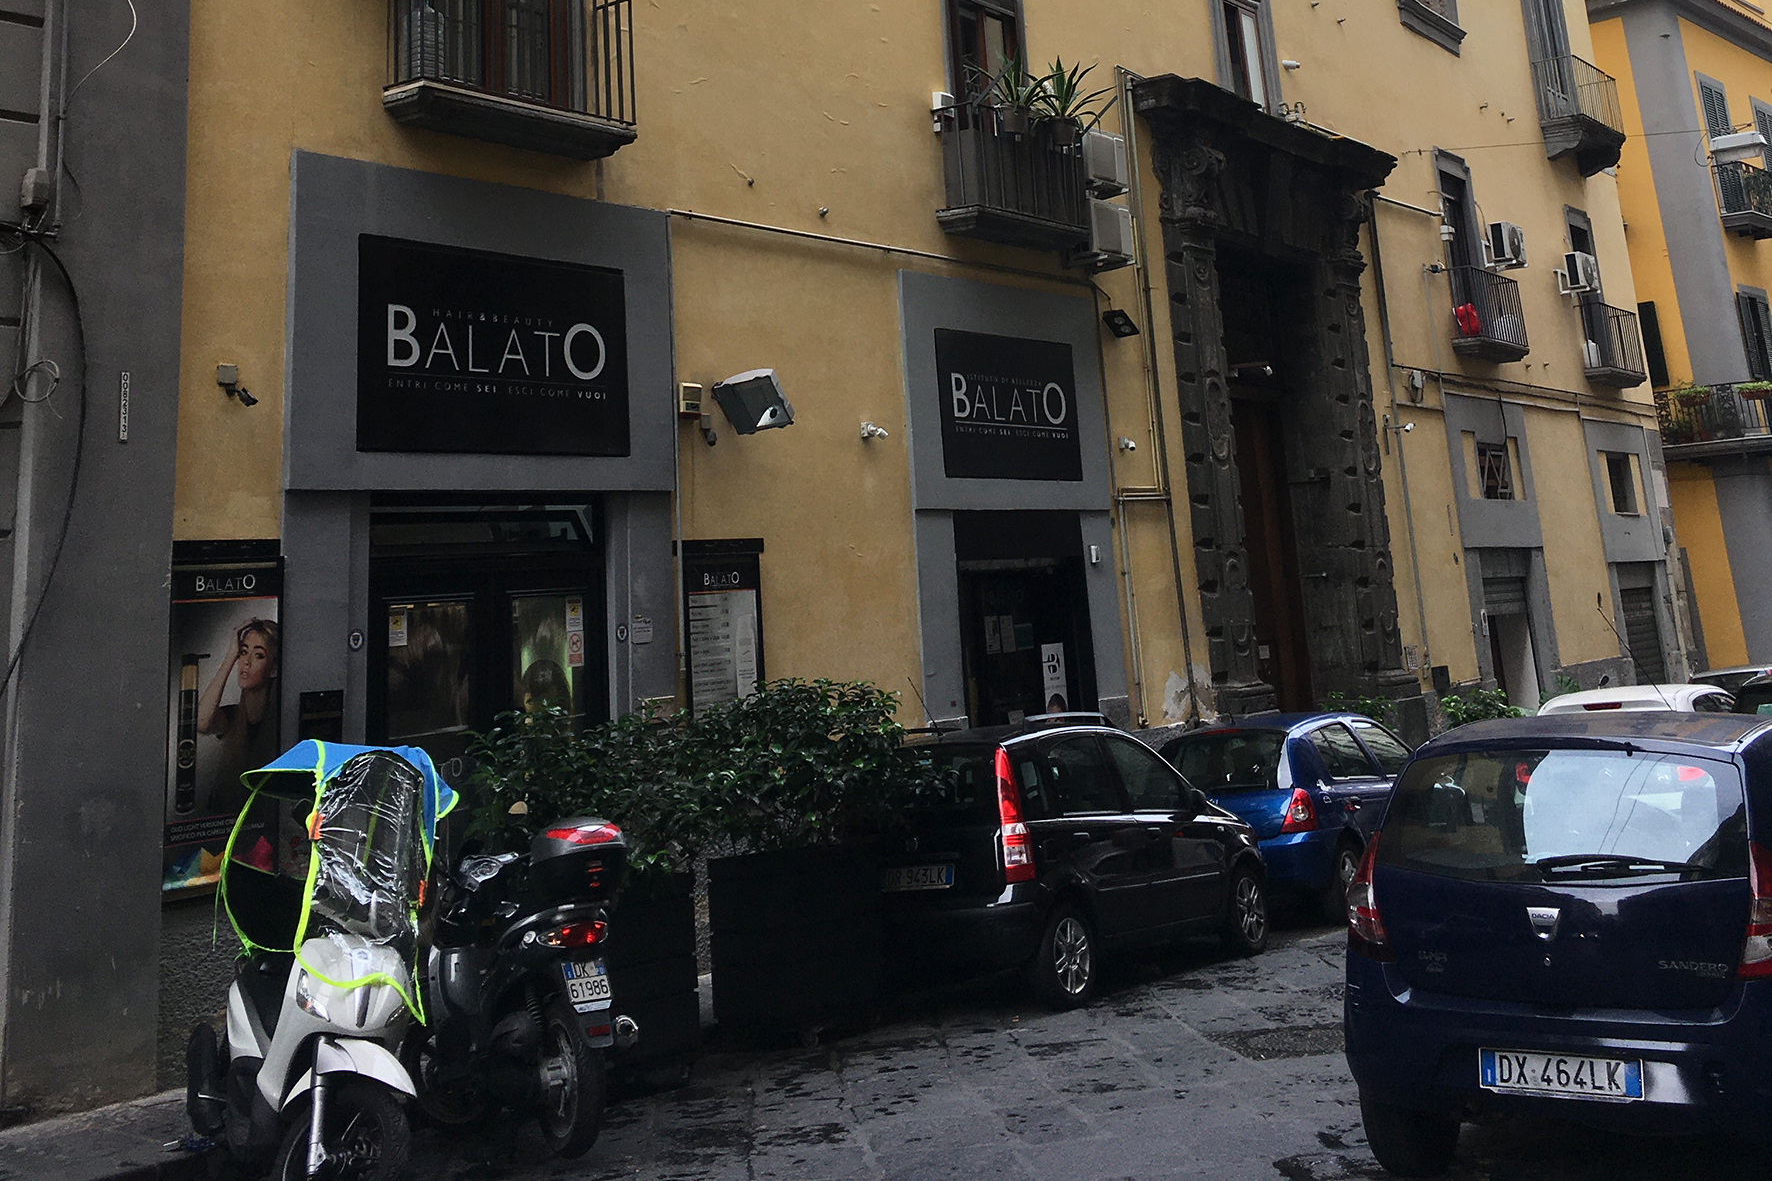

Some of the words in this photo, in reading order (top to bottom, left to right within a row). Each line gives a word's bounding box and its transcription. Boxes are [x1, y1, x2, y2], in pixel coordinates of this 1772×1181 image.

[387, 303, 606, 381] BALATO
[388, 378, 427, 389] ENTRI
[434, 381, 469, 393] COME
[508, 385, 533, 396] ESCI
[540, 388, 570, 398] COME
[577, 390, 606, 400] VUOI
[950, 372, 1067, 425] BALATO
[195, 573, 256, 592] BALATO
[703, 571, 740, 586] BALATO
[1657, 959, 1729, 973] SANDERO
[570, 978, 609, 999] 61986
[1499, 1054, 1529, 1085] DX
[1540, 1057, 1622, 1094] 464LK
